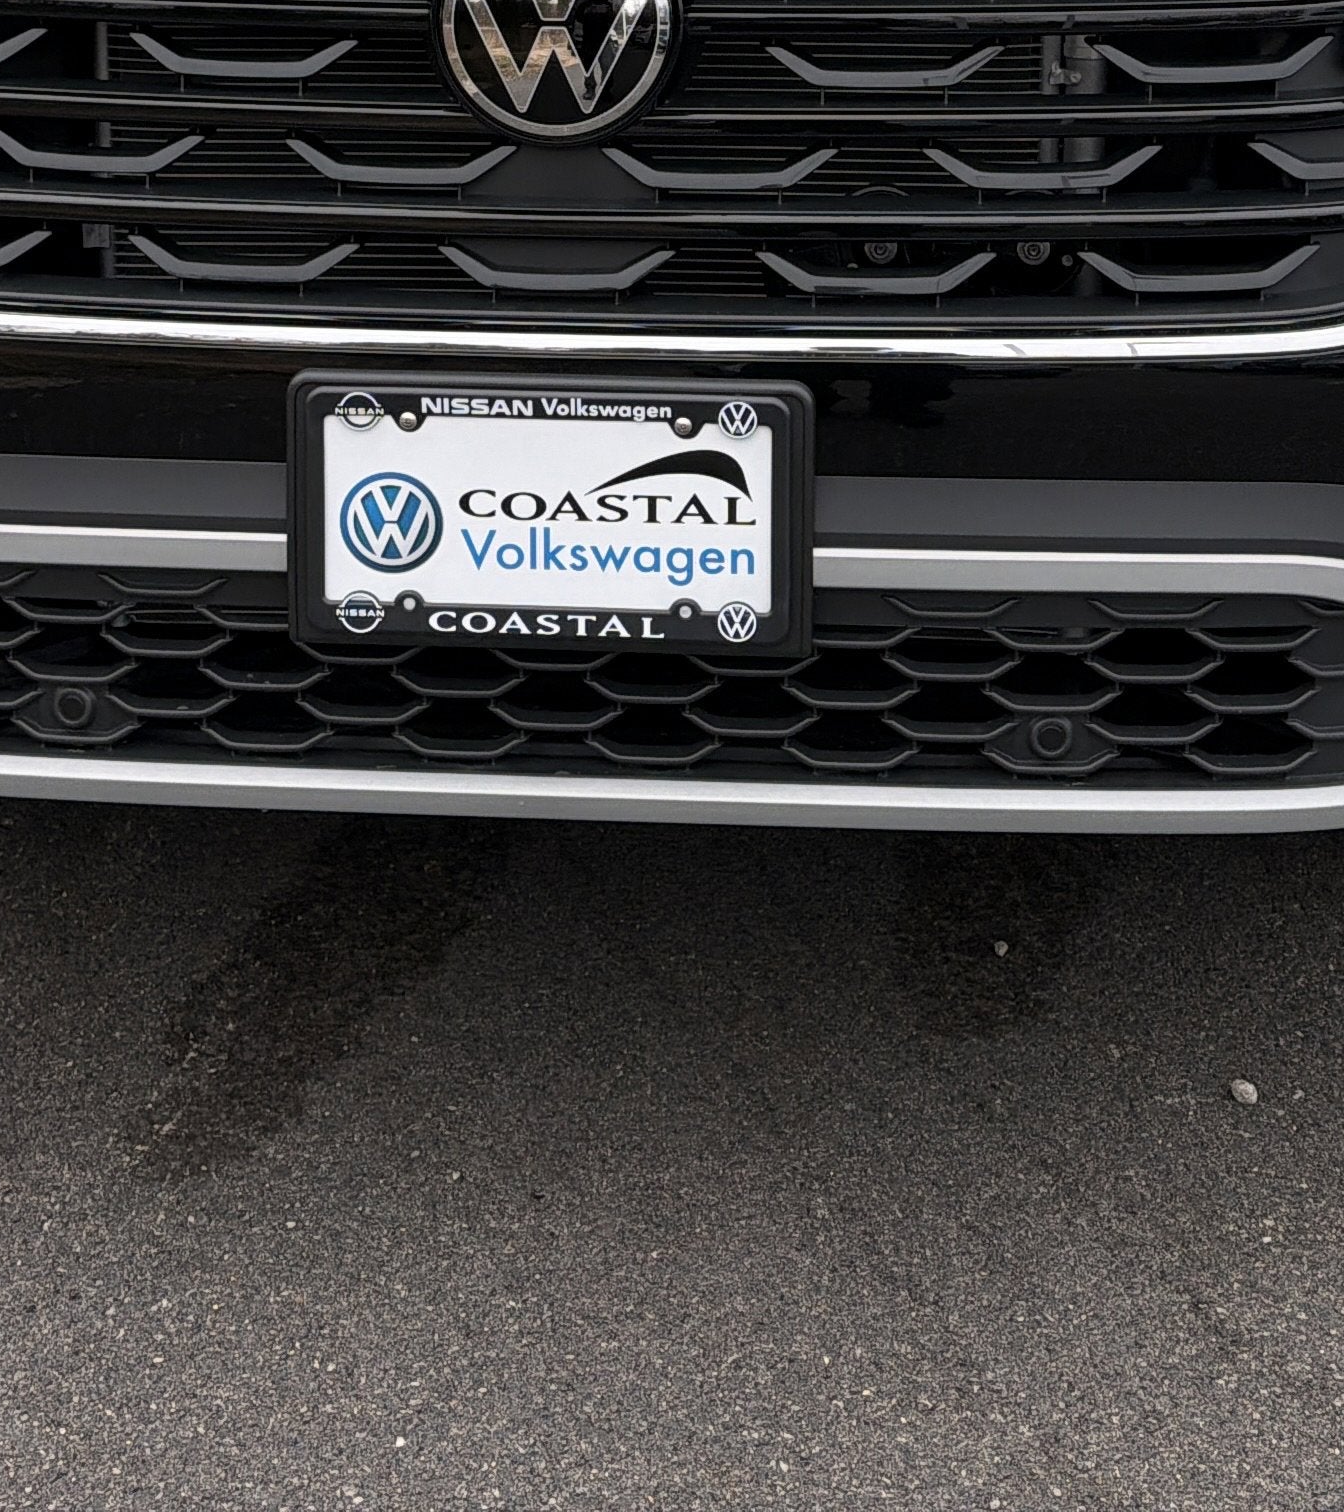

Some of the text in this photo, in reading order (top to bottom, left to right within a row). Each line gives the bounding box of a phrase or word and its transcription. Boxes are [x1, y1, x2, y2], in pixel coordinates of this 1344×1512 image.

[334, 406, 385, 416] NISSAN
[420, 396, 673, 422] NISSAN Volkswagen
[458, 488, 757, 526] COASTAL
[460, 525, 756, 587] Volkswagen
[335, 607, 385, 618] NISSAN
[428, 610, 666, 639] COASTAL
